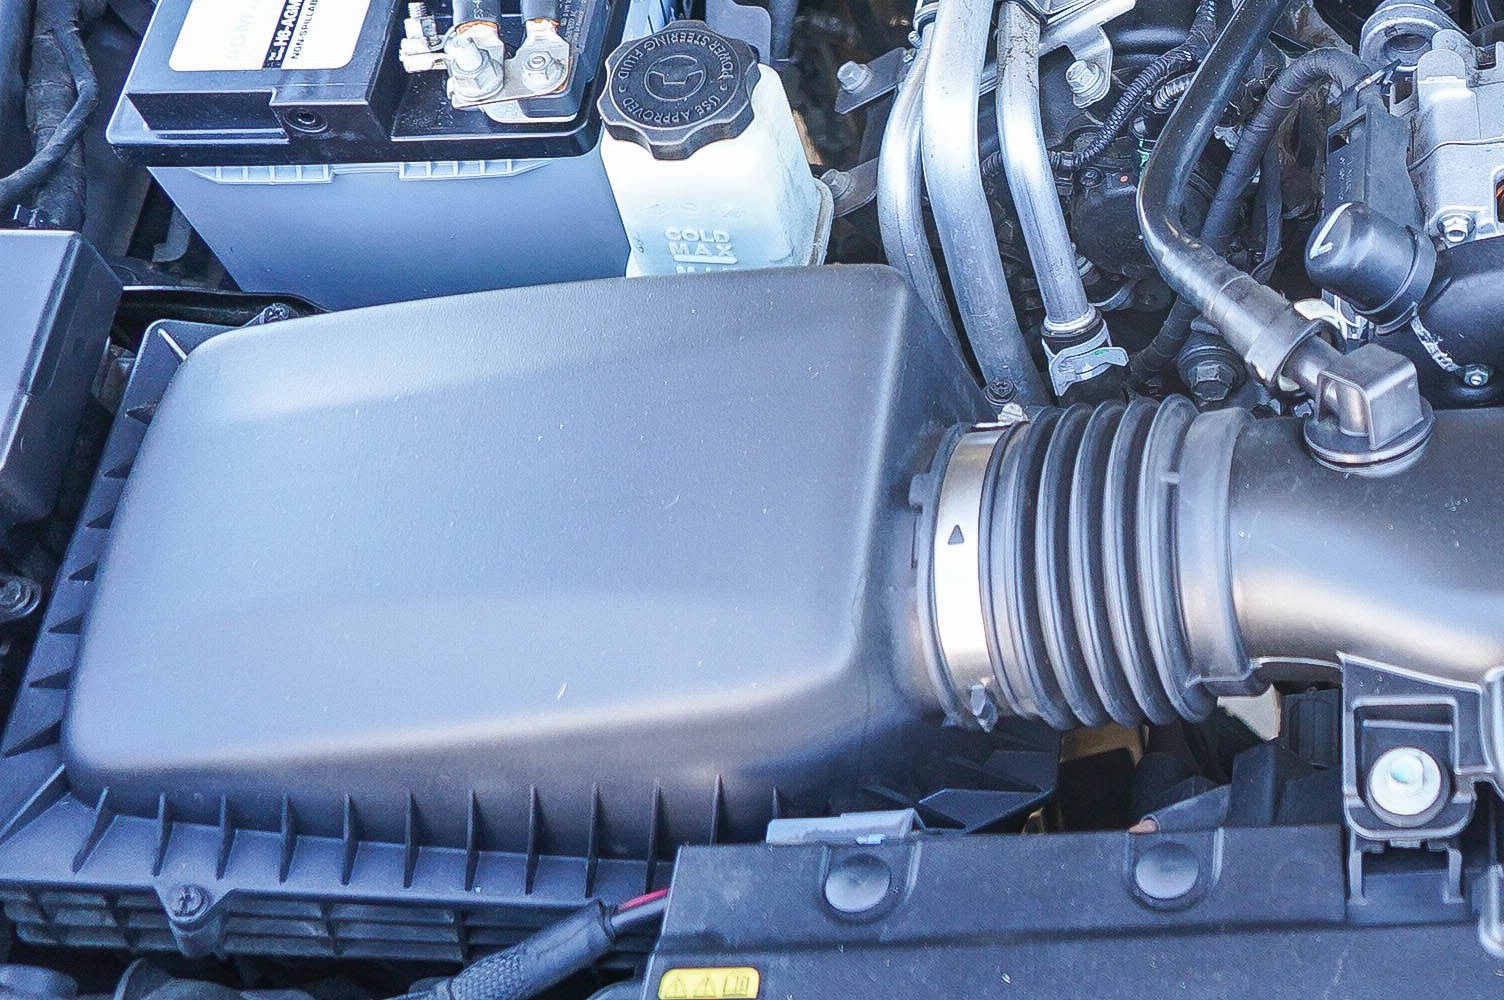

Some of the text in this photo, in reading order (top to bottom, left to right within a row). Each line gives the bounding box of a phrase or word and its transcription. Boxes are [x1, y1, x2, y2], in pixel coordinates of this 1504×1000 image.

[618, 31, 734, 80] POWER STEERING FLUID
[621, 95, 721, 126] USE APPROVED
[664, 226, 730, 243] COLD
[668, 241, 735, 257] MAX
